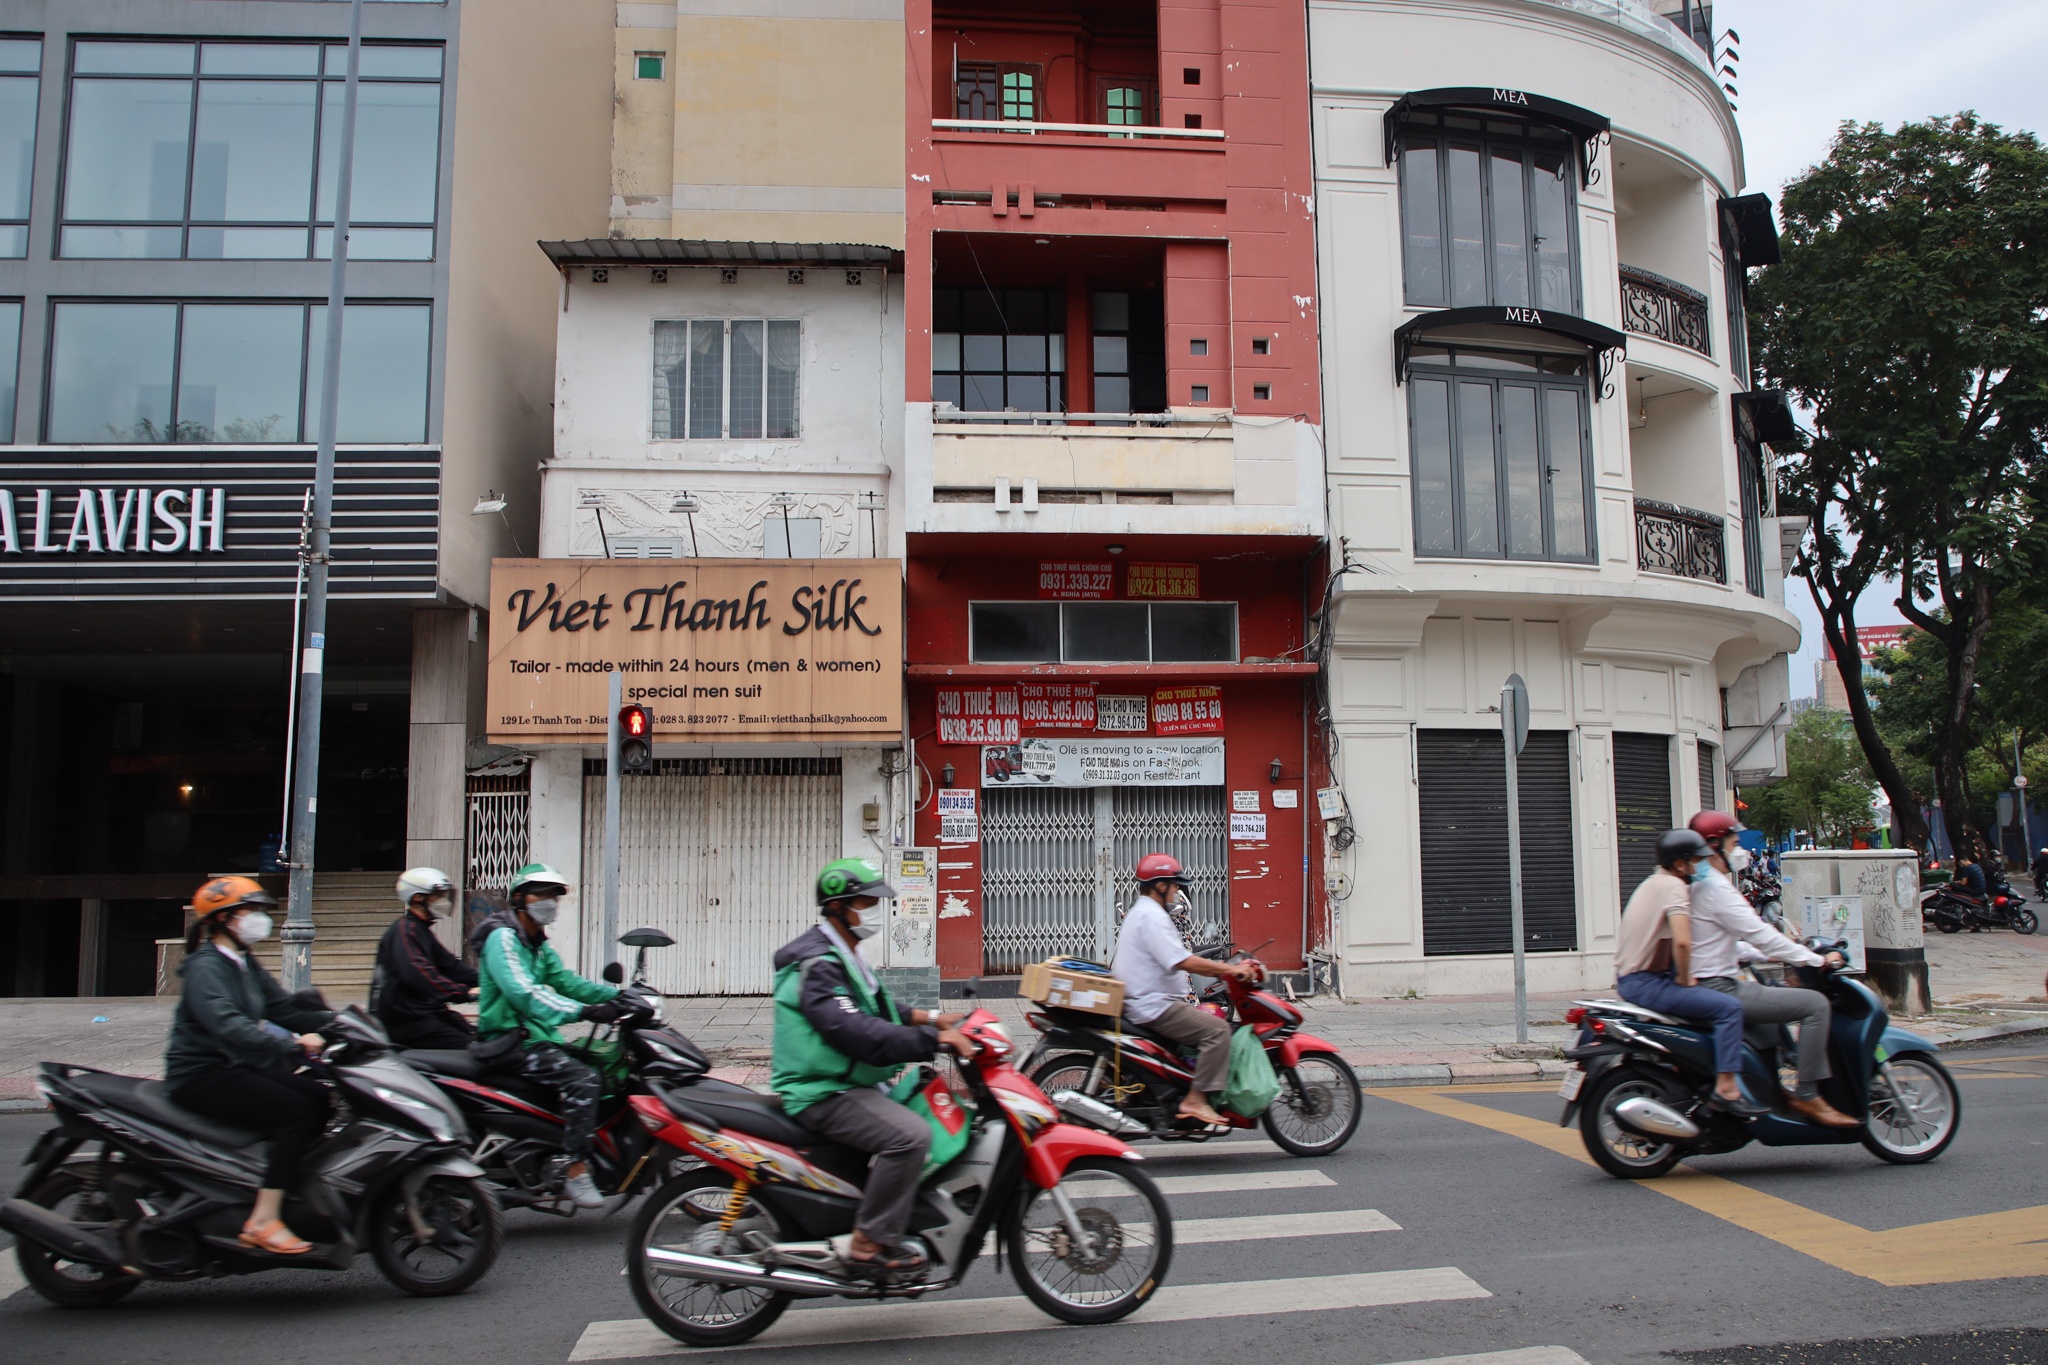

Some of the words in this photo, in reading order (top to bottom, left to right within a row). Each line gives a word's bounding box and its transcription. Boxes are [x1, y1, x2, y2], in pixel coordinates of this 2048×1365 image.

[1493, 88, 1528, 105] MEA
[1506, 307, 1542, 324] MEA
[34, 488, 225, 553] LAVISH
[1040, 573, 1112, 590] 0931.339.227
[1130, 578, 1196, 596] 0922.16.36.36
[508, 582, 612, 633] Viet
[623, 580, 772, 632] Thanh
[782, 578, 882, 636] Silk
[510, 659, 550, 673] Tailor
[565, 659, 614, 673] made
[618, 659, 663, 672] within
[670, 659, 689, 672] 24
[695, 659, 740, 672] hours
[746, 659, 790, 673] (men
[796, 659, 808, 672] &
[816, 659, 881, 673] women)
[628, 685, 687, 700] special
[693, 687, 729, 698] men
[735, 685, 762, 698] suit
[1022, 686, 1043, 697] CHO
[1046, 685, 1071, 697] THUÊ
[1075, 685, 1095, 697] NHÀ
[1156, 690, 1173, 700] CHO
[1174, 688, 1197, 699] THUÊ
[938, 692, 960, 715] CHO
[964, 687, 992, 715] THUÊ
[996, 687, 1020, 715] NHÀ
[1114, 699, 1127, 712] CHO
[1129, 697, 1145, 713] THUÊ
[1022, 700, 1094, 721] 0906.905.006
[1155, 703, 1179, 723] 0909
[1181, 702, 1193, 720] 88
[1195, 701, 1207, 719] 55
[501, 716, 517, 725] 129
[518, 716, 531, 724] Le
[532, 716, 562, 724] Thanh
[564, 716, 582, 724] Ton
[660, 716, 677, 724] 028
[706, 715, 728, 723] 2077
[738, 715, 769, 723] Email:
[771, 714, 887, 724] vietthanhsilk@yahoo.com
[1099, 715, 1146, 729] 0972.964.076
[940, 718, 1019, 742] 0938.25.99.09
[1060, 745, 1077, 755] Olé
[1081, 745, 1089, 754] is
[1093, 745, 1130, 756] moving
[1134, 745, 1143, 754] to
[1180, 745, 1222, 754] location.
[1023, 761, 1056, 770] 0911.7777.69
[1086, 757, 1096, 767] CHO
[1133, 759, 1146, 767] on
[1086, 770, 1120, 780] 0909.31.32.03
[1232, 824, 1265, 832] 0903.764.236
